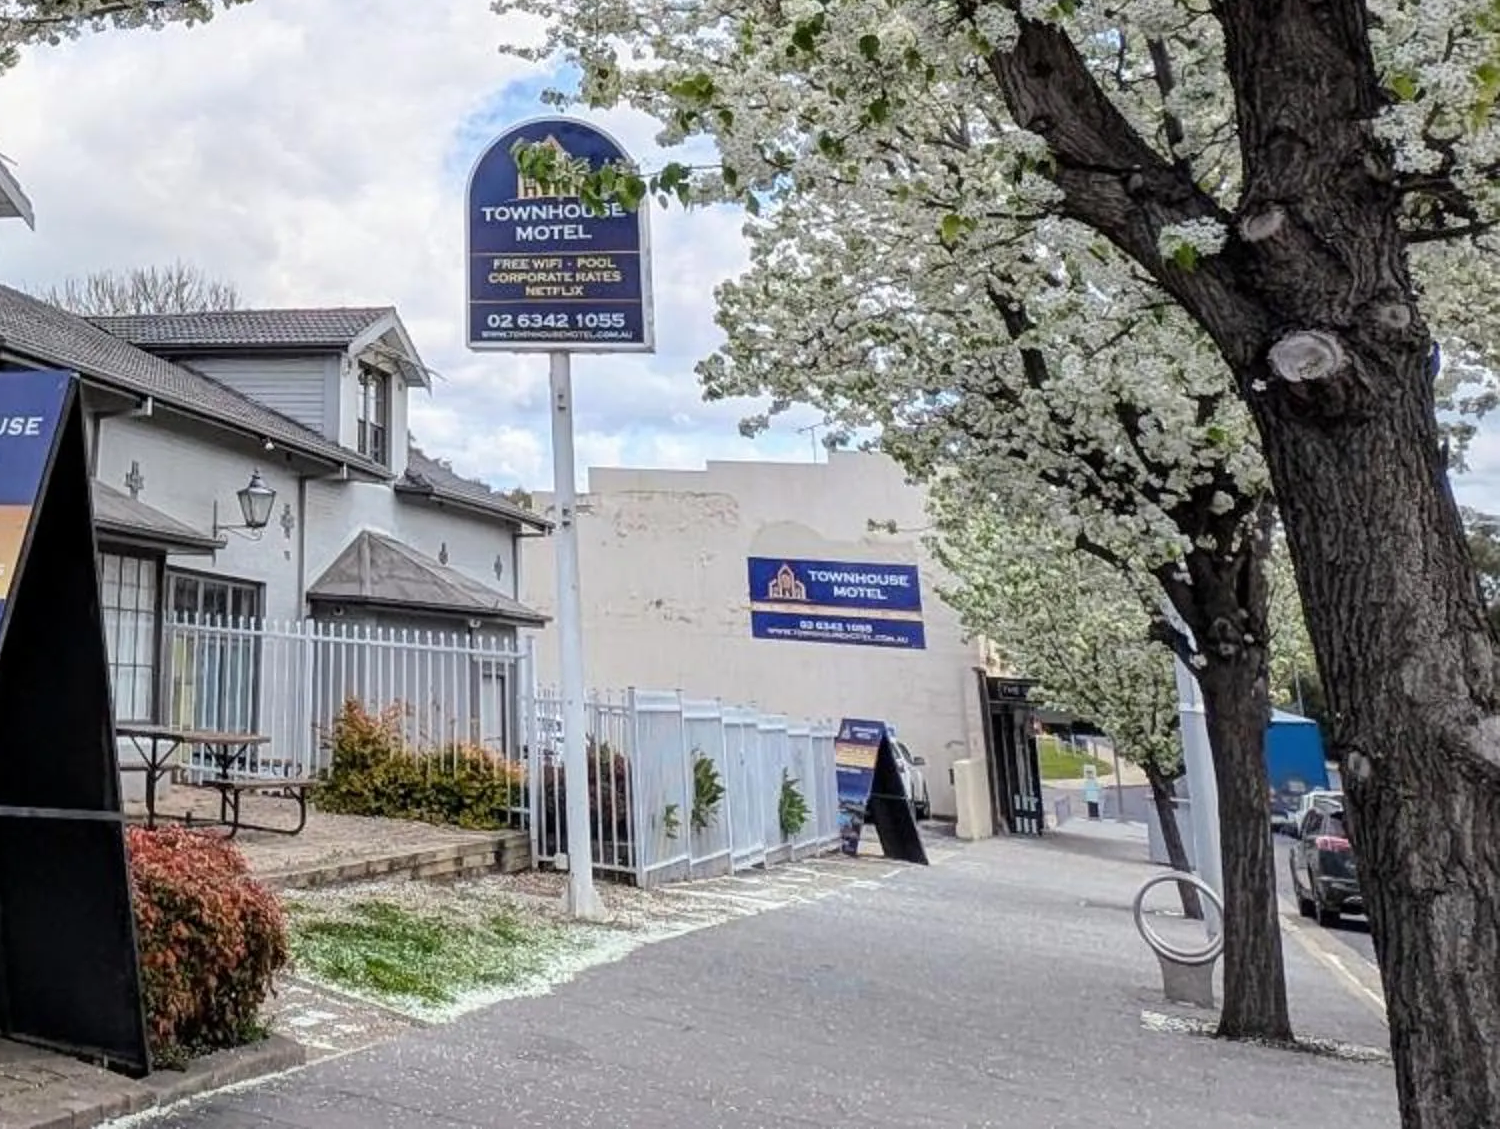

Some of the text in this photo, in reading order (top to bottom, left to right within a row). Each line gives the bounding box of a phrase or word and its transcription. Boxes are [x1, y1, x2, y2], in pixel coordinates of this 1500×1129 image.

[515, 224, 593, 241] MOTEL
[493, 257, 617, 270] FREE WIFI POOL
[488, 270, 622, 284] CORPORATE RATES
[525, 285, 584, 296] NETFLIX
[487, 313, 626, 328] 02 6342 1055
[807, 570, 910, 587] TOWNHOUSE
[833, 585, 887, 600] MOTEL
